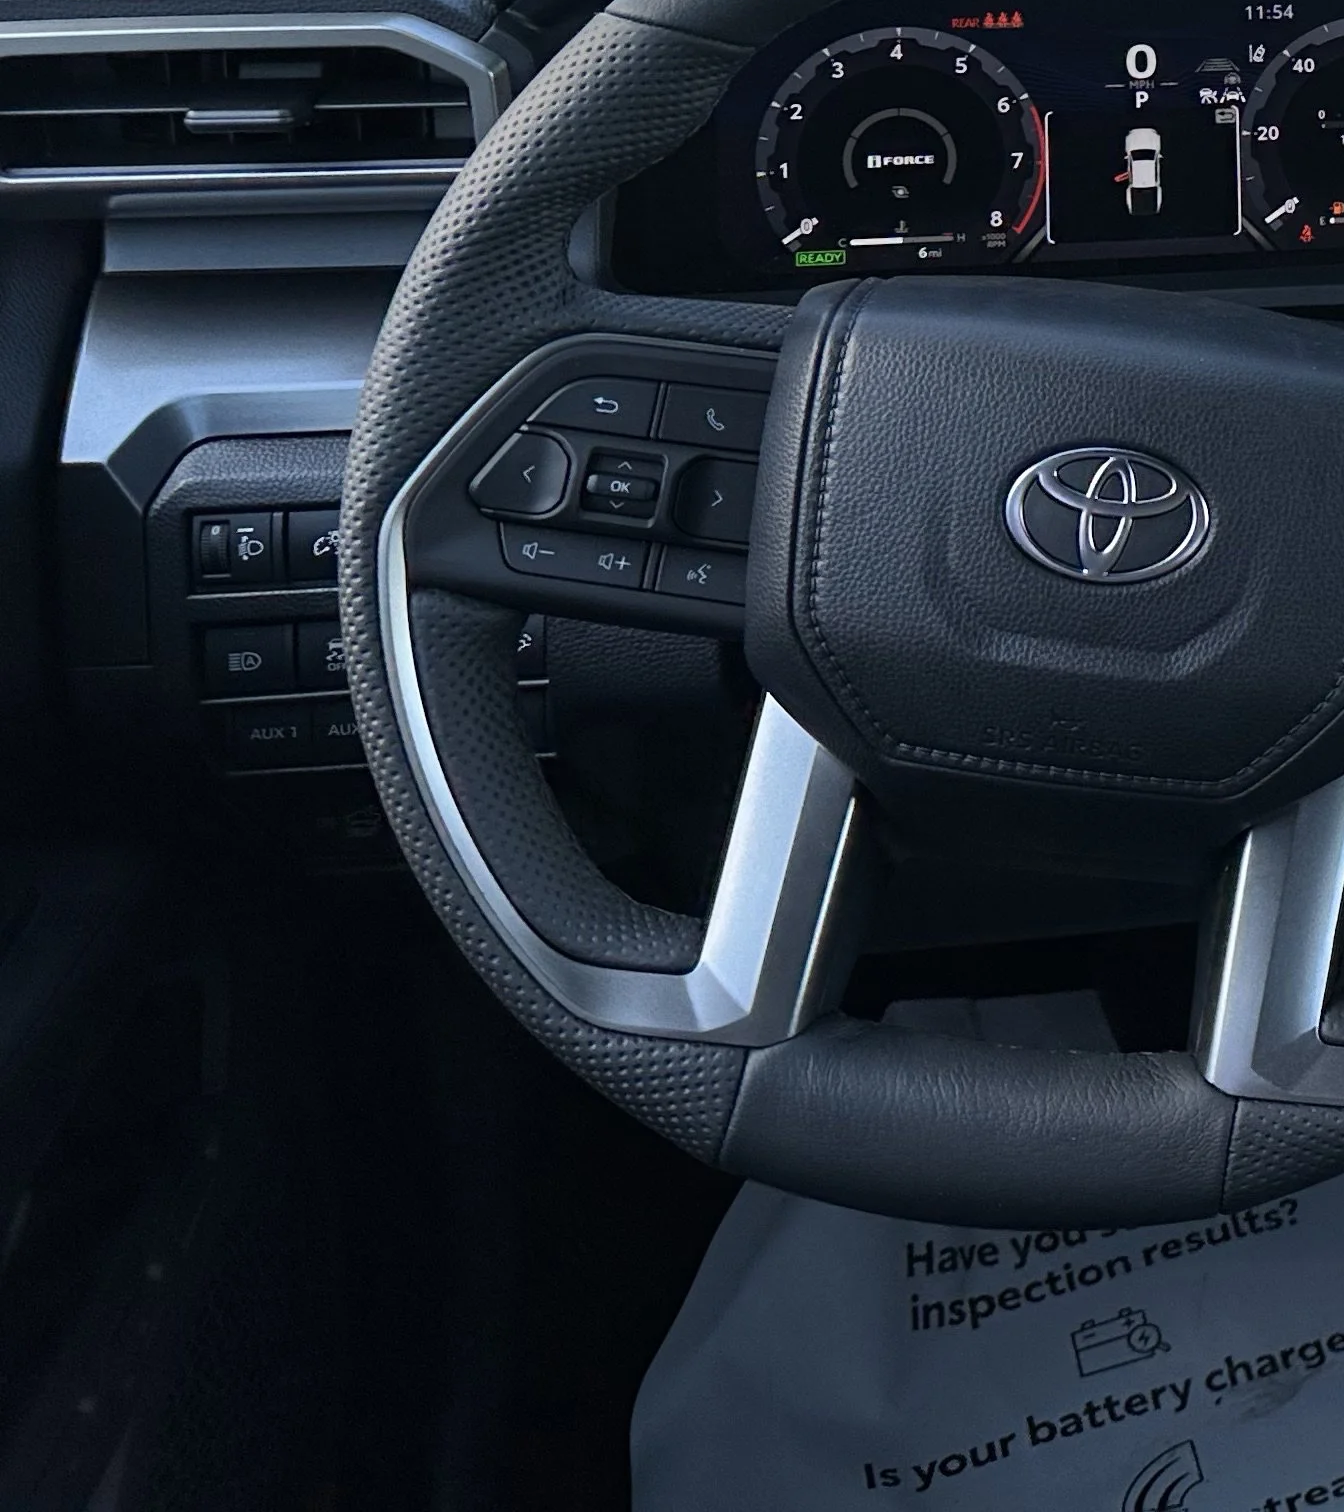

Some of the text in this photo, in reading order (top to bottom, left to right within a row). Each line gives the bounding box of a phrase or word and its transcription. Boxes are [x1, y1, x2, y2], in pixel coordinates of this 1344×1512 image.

[1245, 4, 1294, 20] 11:54
[951, 18, 980, 29] REAR
[890, 44, 903, 60] 4
[831, 61, 844, 78] 3
[955, 57, 968, 74] 5
[1125, 44, 1157, 79] 0
[1291, 58, 1316, 73] 40
[1129, 80, 1155, 89] MPH
[997, 96, 1010, 113] 6
[1135, 91, 1149, 108] P
[790, 103, 803, 120] 2
[1318, 110, 1326, 119] 0
[1257, 126, 1280, 141] 20
[1011, 152, 1024, 169] 7
[779, 162, 789, 179] 1
[800, 218, 814, 235] 0
[990, 210, 1003, 227] 8
[799, 252, 842, 264] READY
[609, 479, 632, 494] OK
[249, 725, 298, 740] AUX 1
[905, 1240, 1000, 1278] Have
[910, 1198, 1299, 1331] inspection results?
[863, 1462, 902, 1490] Is
[911, 1431, 1018, 1493] your
[1026, 1378, 1192, 1448] battery
